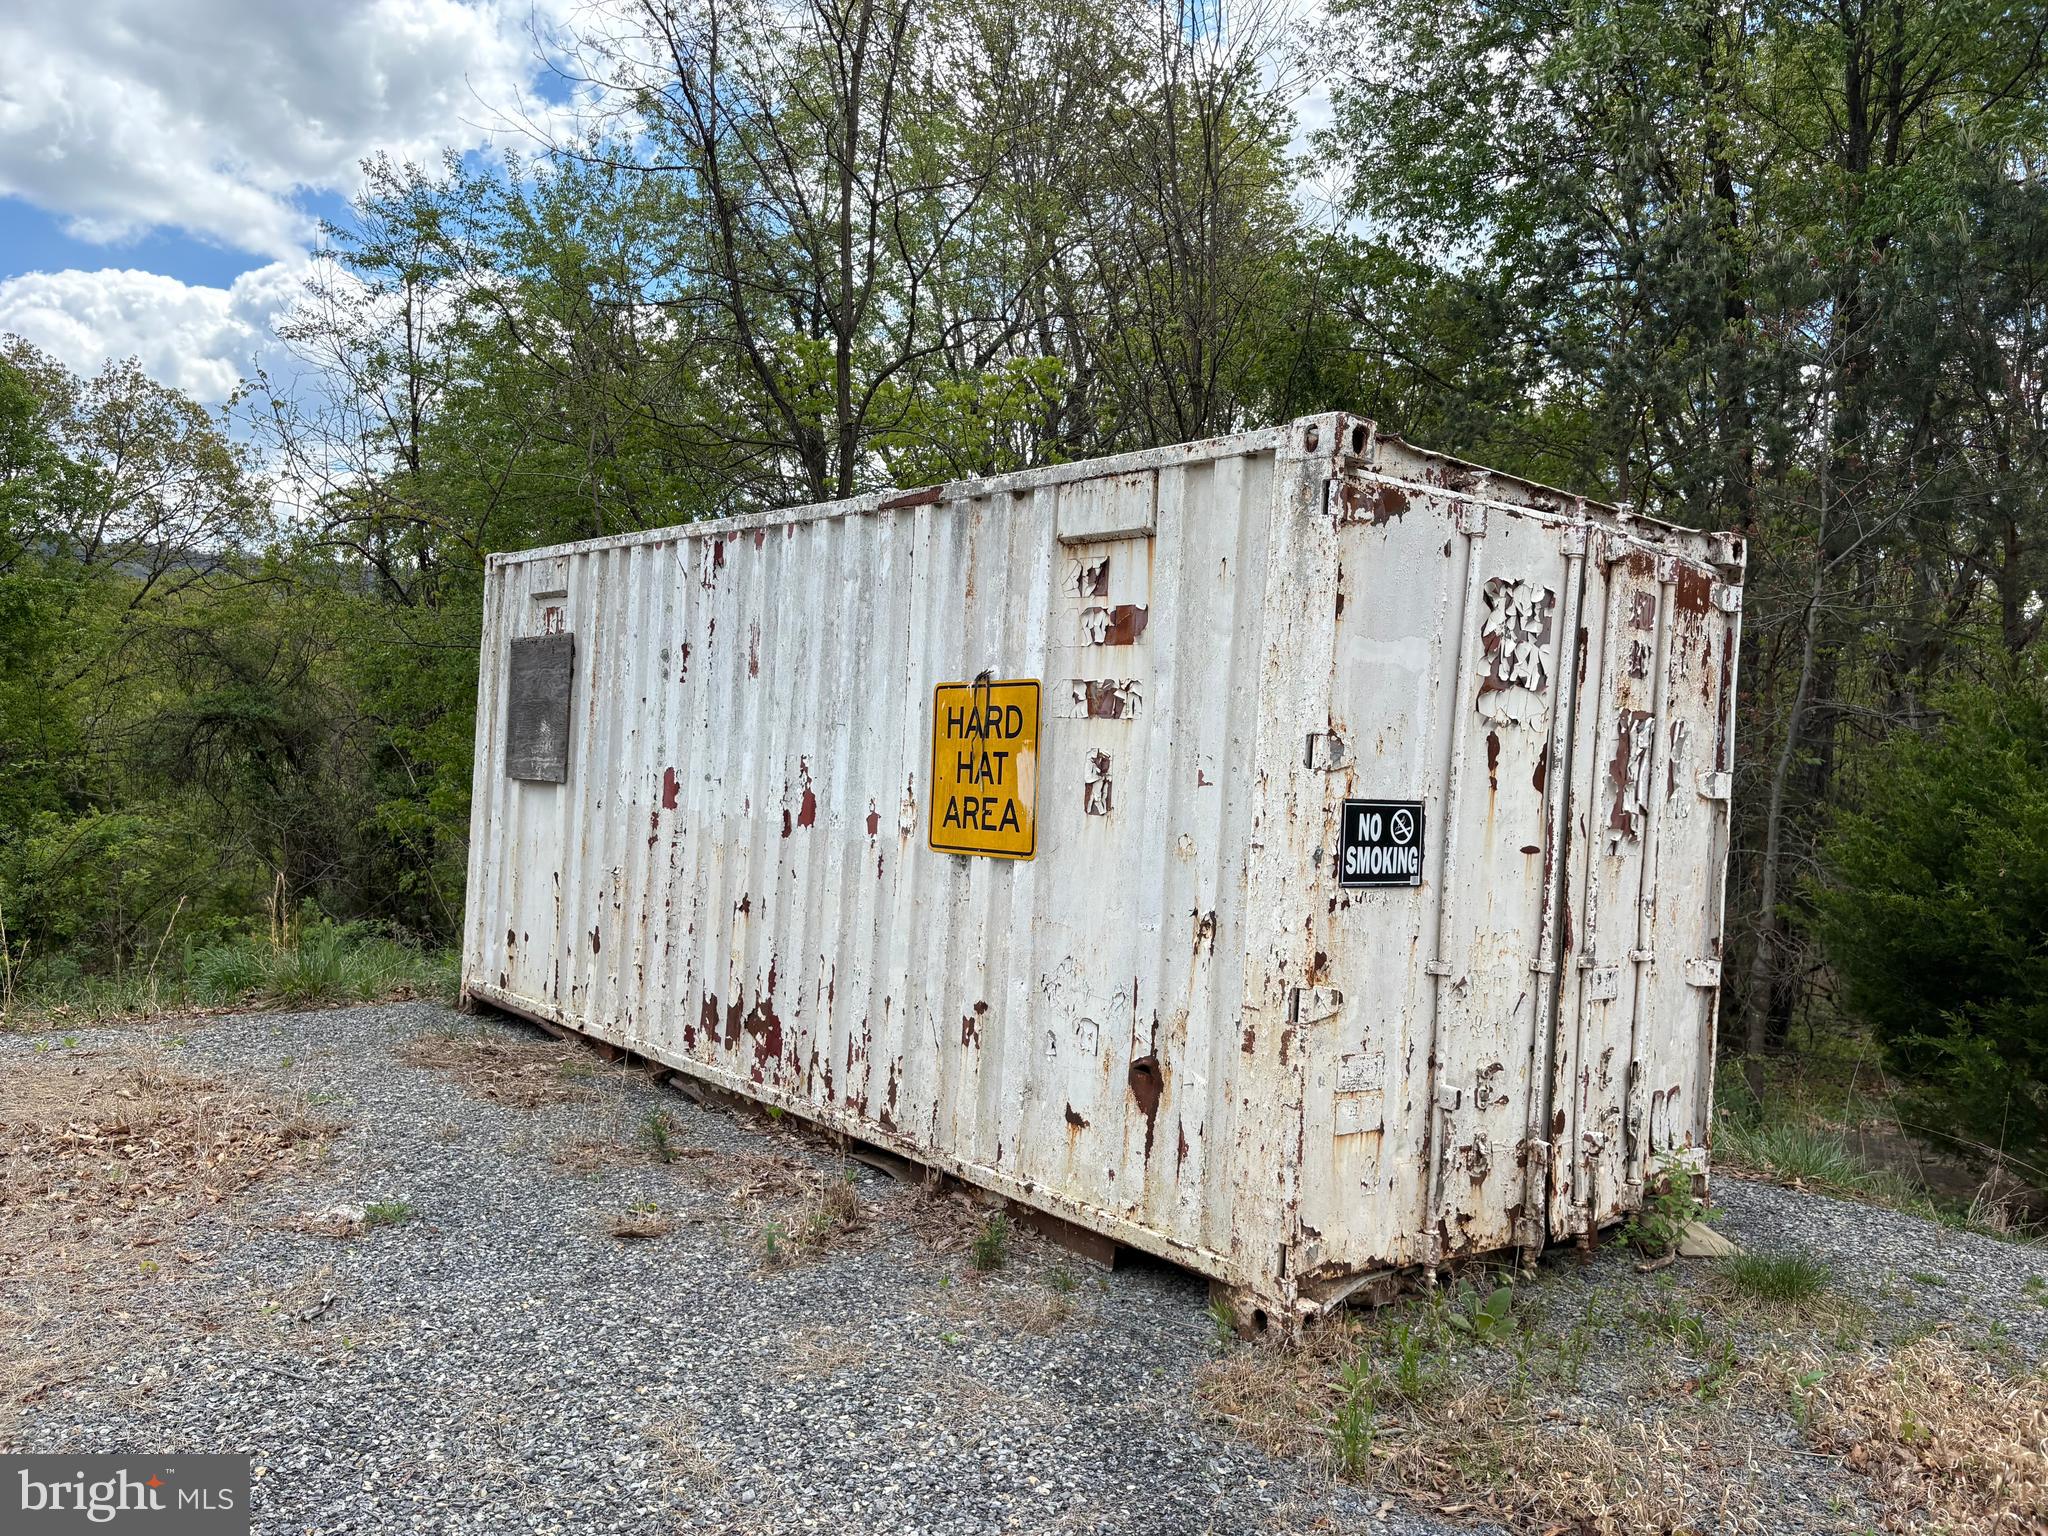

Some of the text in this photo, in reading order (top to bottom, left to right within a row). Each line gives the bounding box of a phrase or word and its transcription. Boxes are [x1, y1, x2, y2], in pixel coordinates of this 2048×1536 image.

[947, 705, 1023, 739] HARD
[956, 752, 1009, 785] HAT
[942, 796, 1020, 833] AREA
[1358, 813, 1382, 842] NO
[1345, 846, 1418, 875] SMOKING
